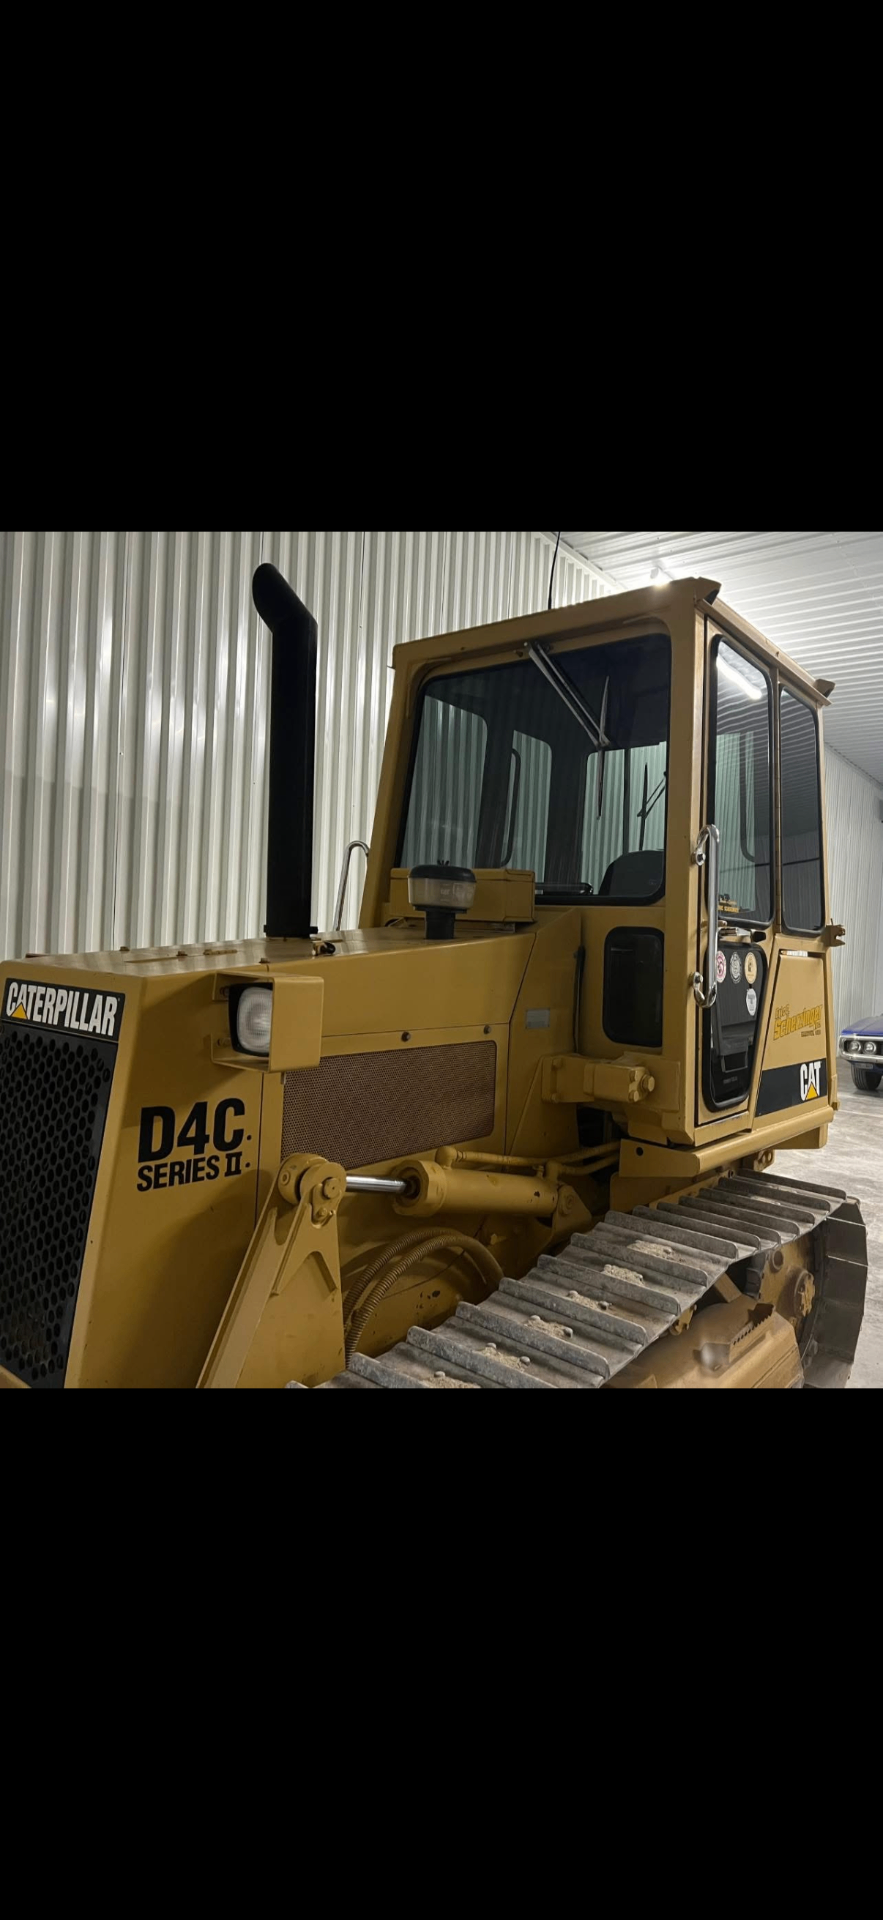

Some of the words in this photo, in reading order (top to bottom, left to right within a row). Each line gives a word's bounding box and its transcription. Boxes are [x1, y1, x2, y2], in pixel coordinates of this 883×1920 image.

[6, 982, 118, 1036] CATERPILLAR
[800, 1061, 822, 1101] CAT
[138, 1098, 245, 1163] D4C
[137, 1155, 220, 1192] SERIES
[224, 1151, 242, 1177] II
